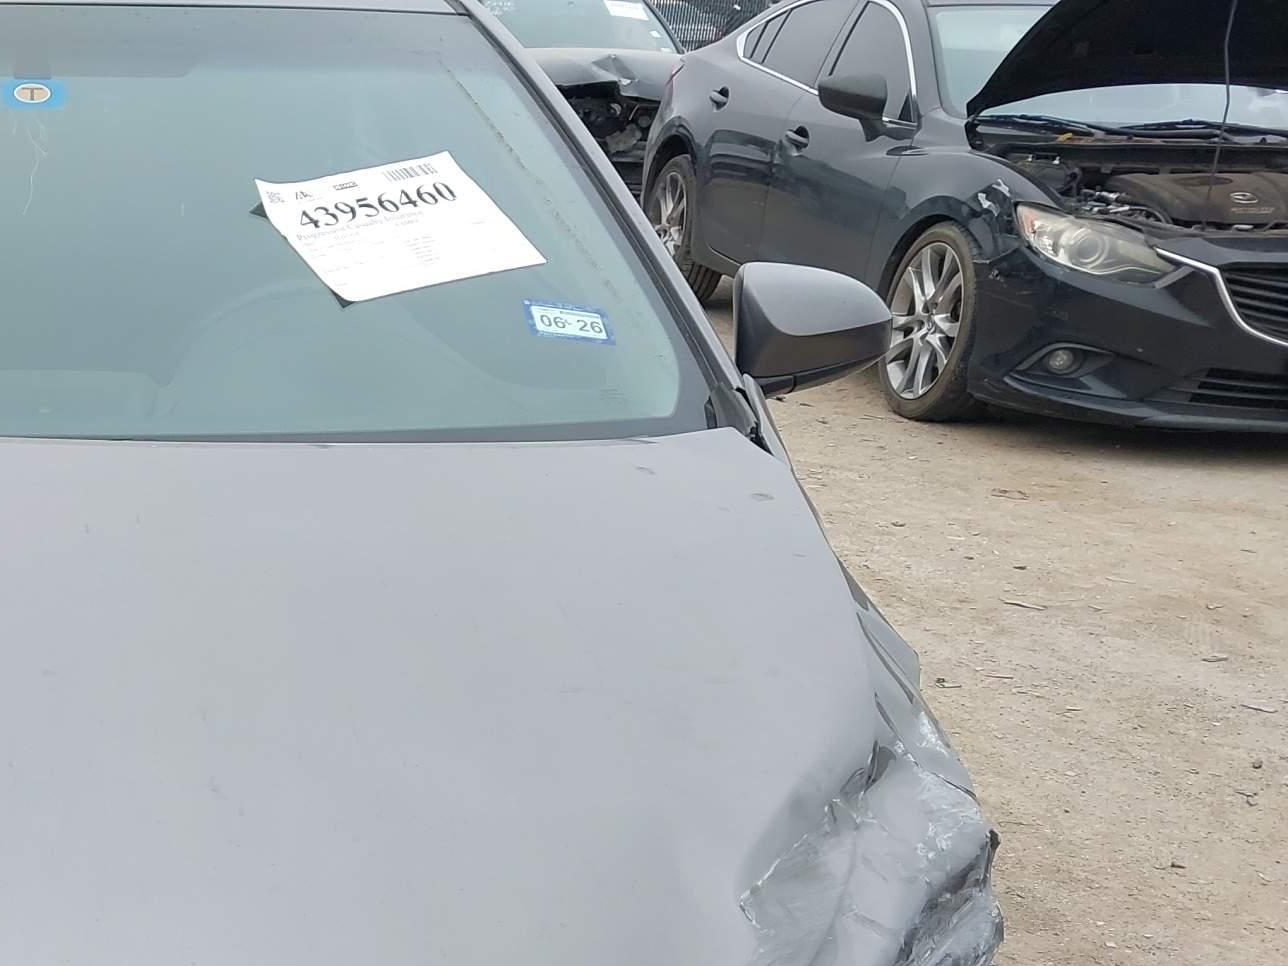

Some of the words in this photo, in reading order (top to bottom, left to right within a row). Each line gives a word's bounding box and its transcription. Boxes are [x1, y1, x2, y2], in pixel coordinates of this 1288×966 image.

[300, 182, 457, 229] 43956460
[540, 314, 566, 329] 06
[576, 319, 604, 334] 26
